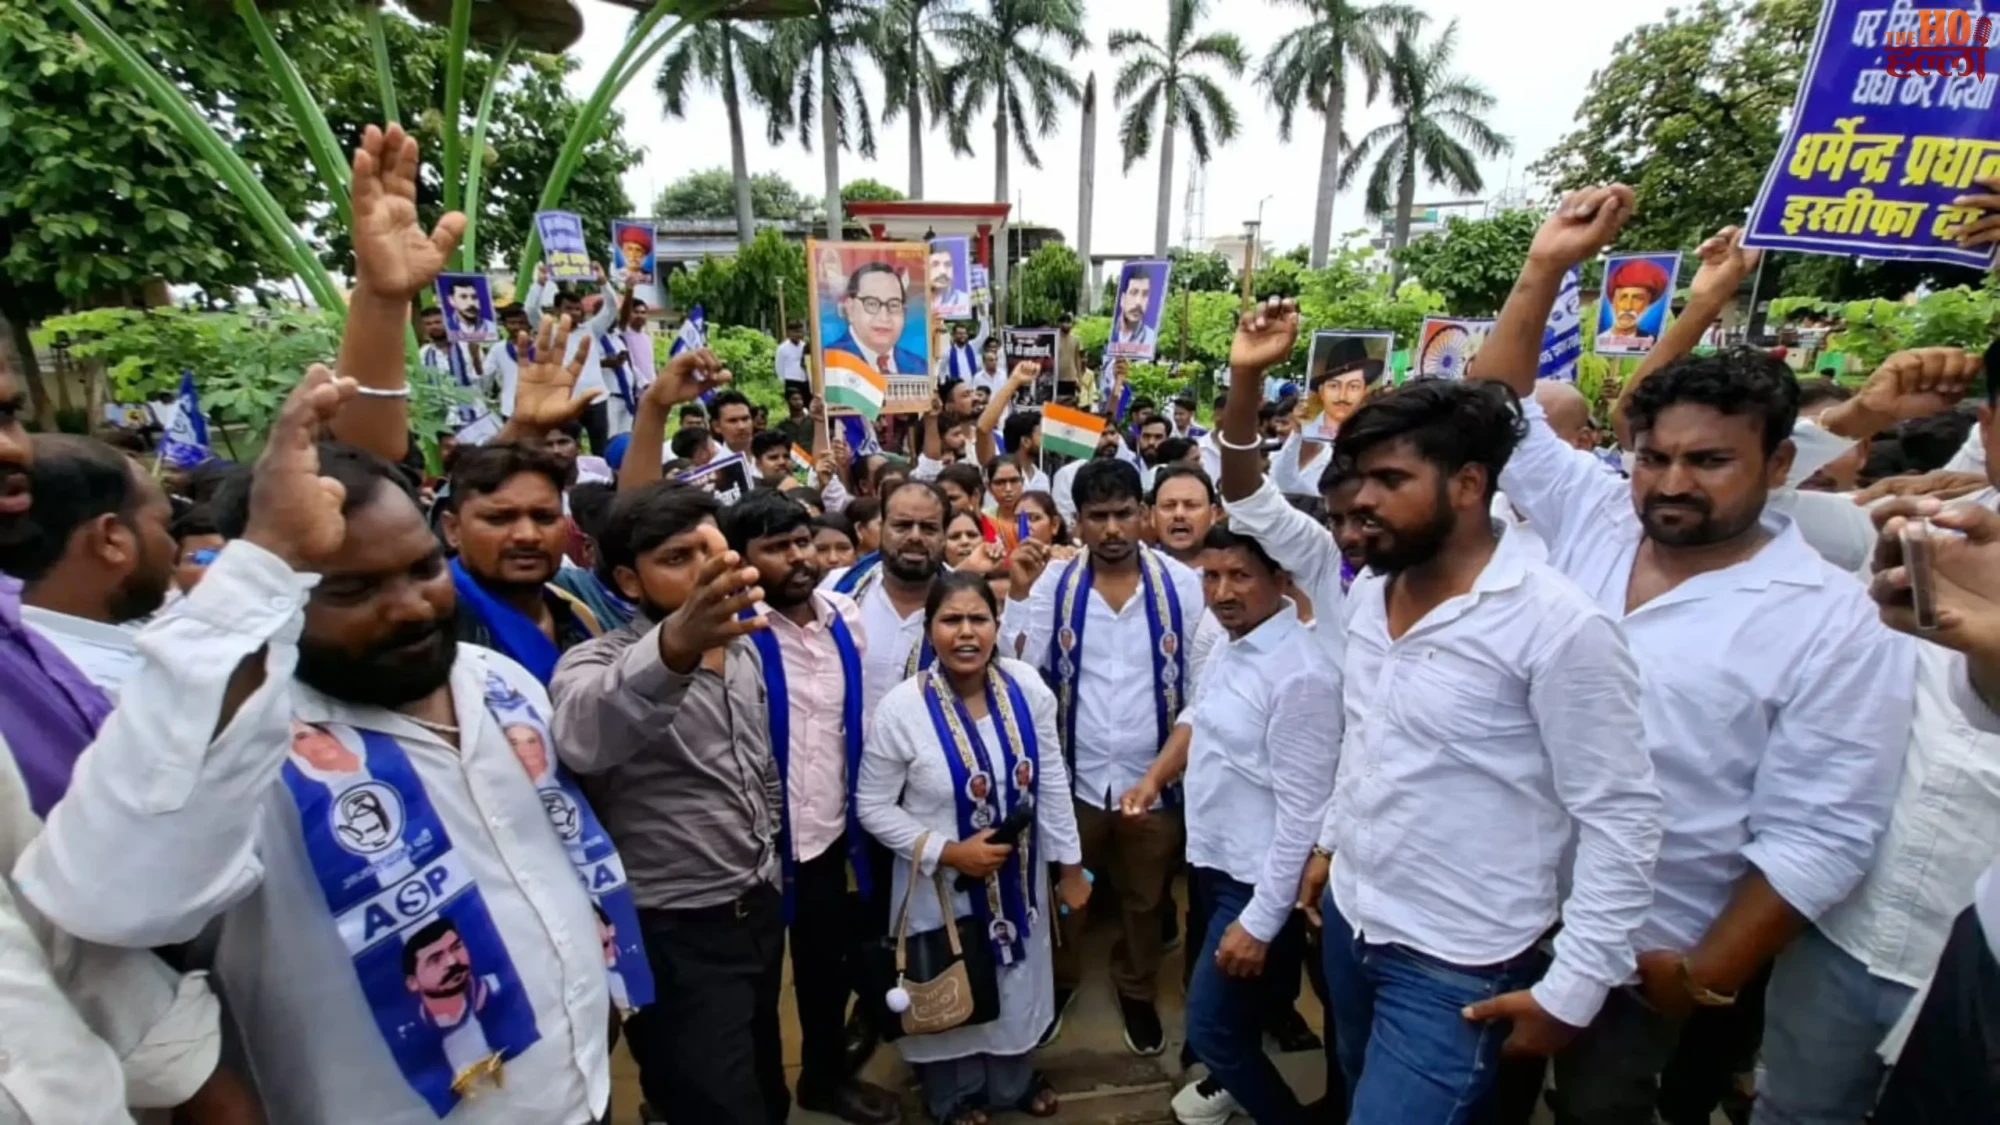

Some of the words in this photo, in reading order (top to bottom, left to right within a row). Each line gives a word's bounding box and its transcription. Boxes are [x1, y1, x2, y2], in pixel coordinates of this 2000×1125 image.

[1899, 69, 1941, 108] कर
[1788, 116, 1905, 183] धर्मेन्द्र
[1780, 188, 1929, 238] इस्तीफा
[364, 865, 449, 942] ASP
